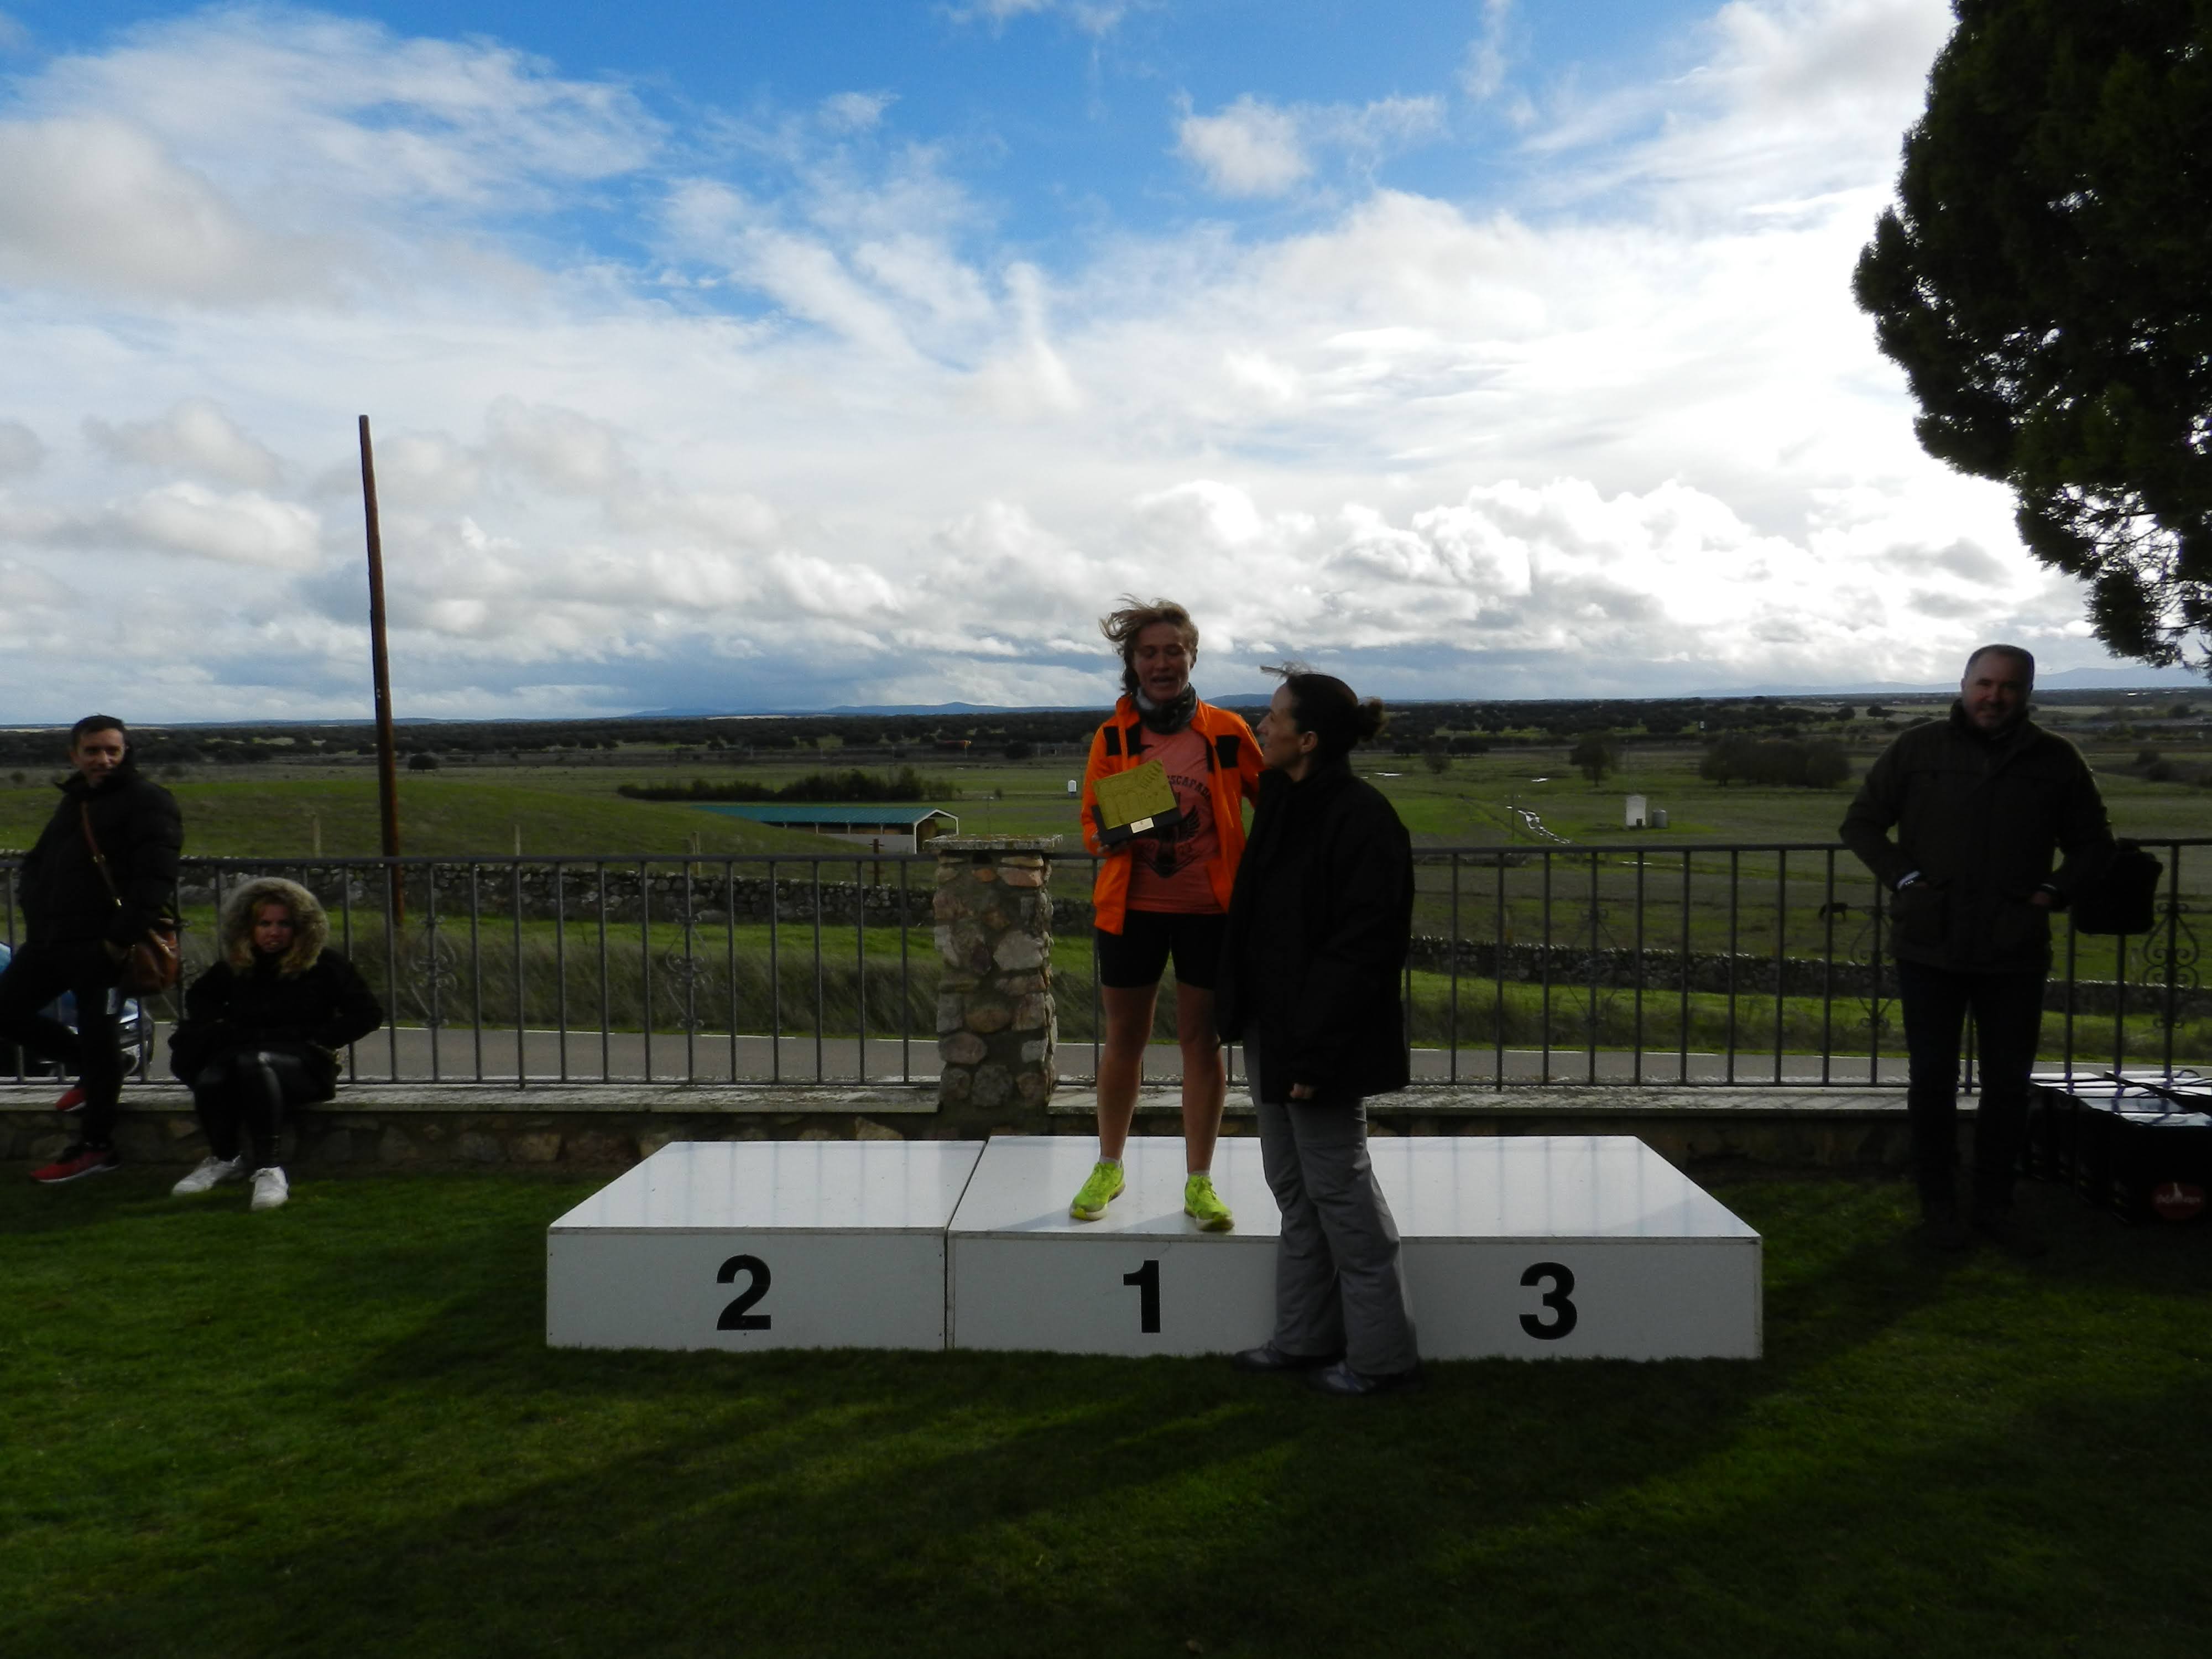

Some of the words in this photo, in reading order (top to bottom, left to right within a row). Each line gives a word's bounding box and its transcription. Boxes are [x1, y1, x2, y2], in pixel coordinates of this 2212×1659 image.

[717, 1254, 771, 1331] 2
[1124, 1260, 1160, 1333] 1
[1520, 1262, 1577, 1340] 3
